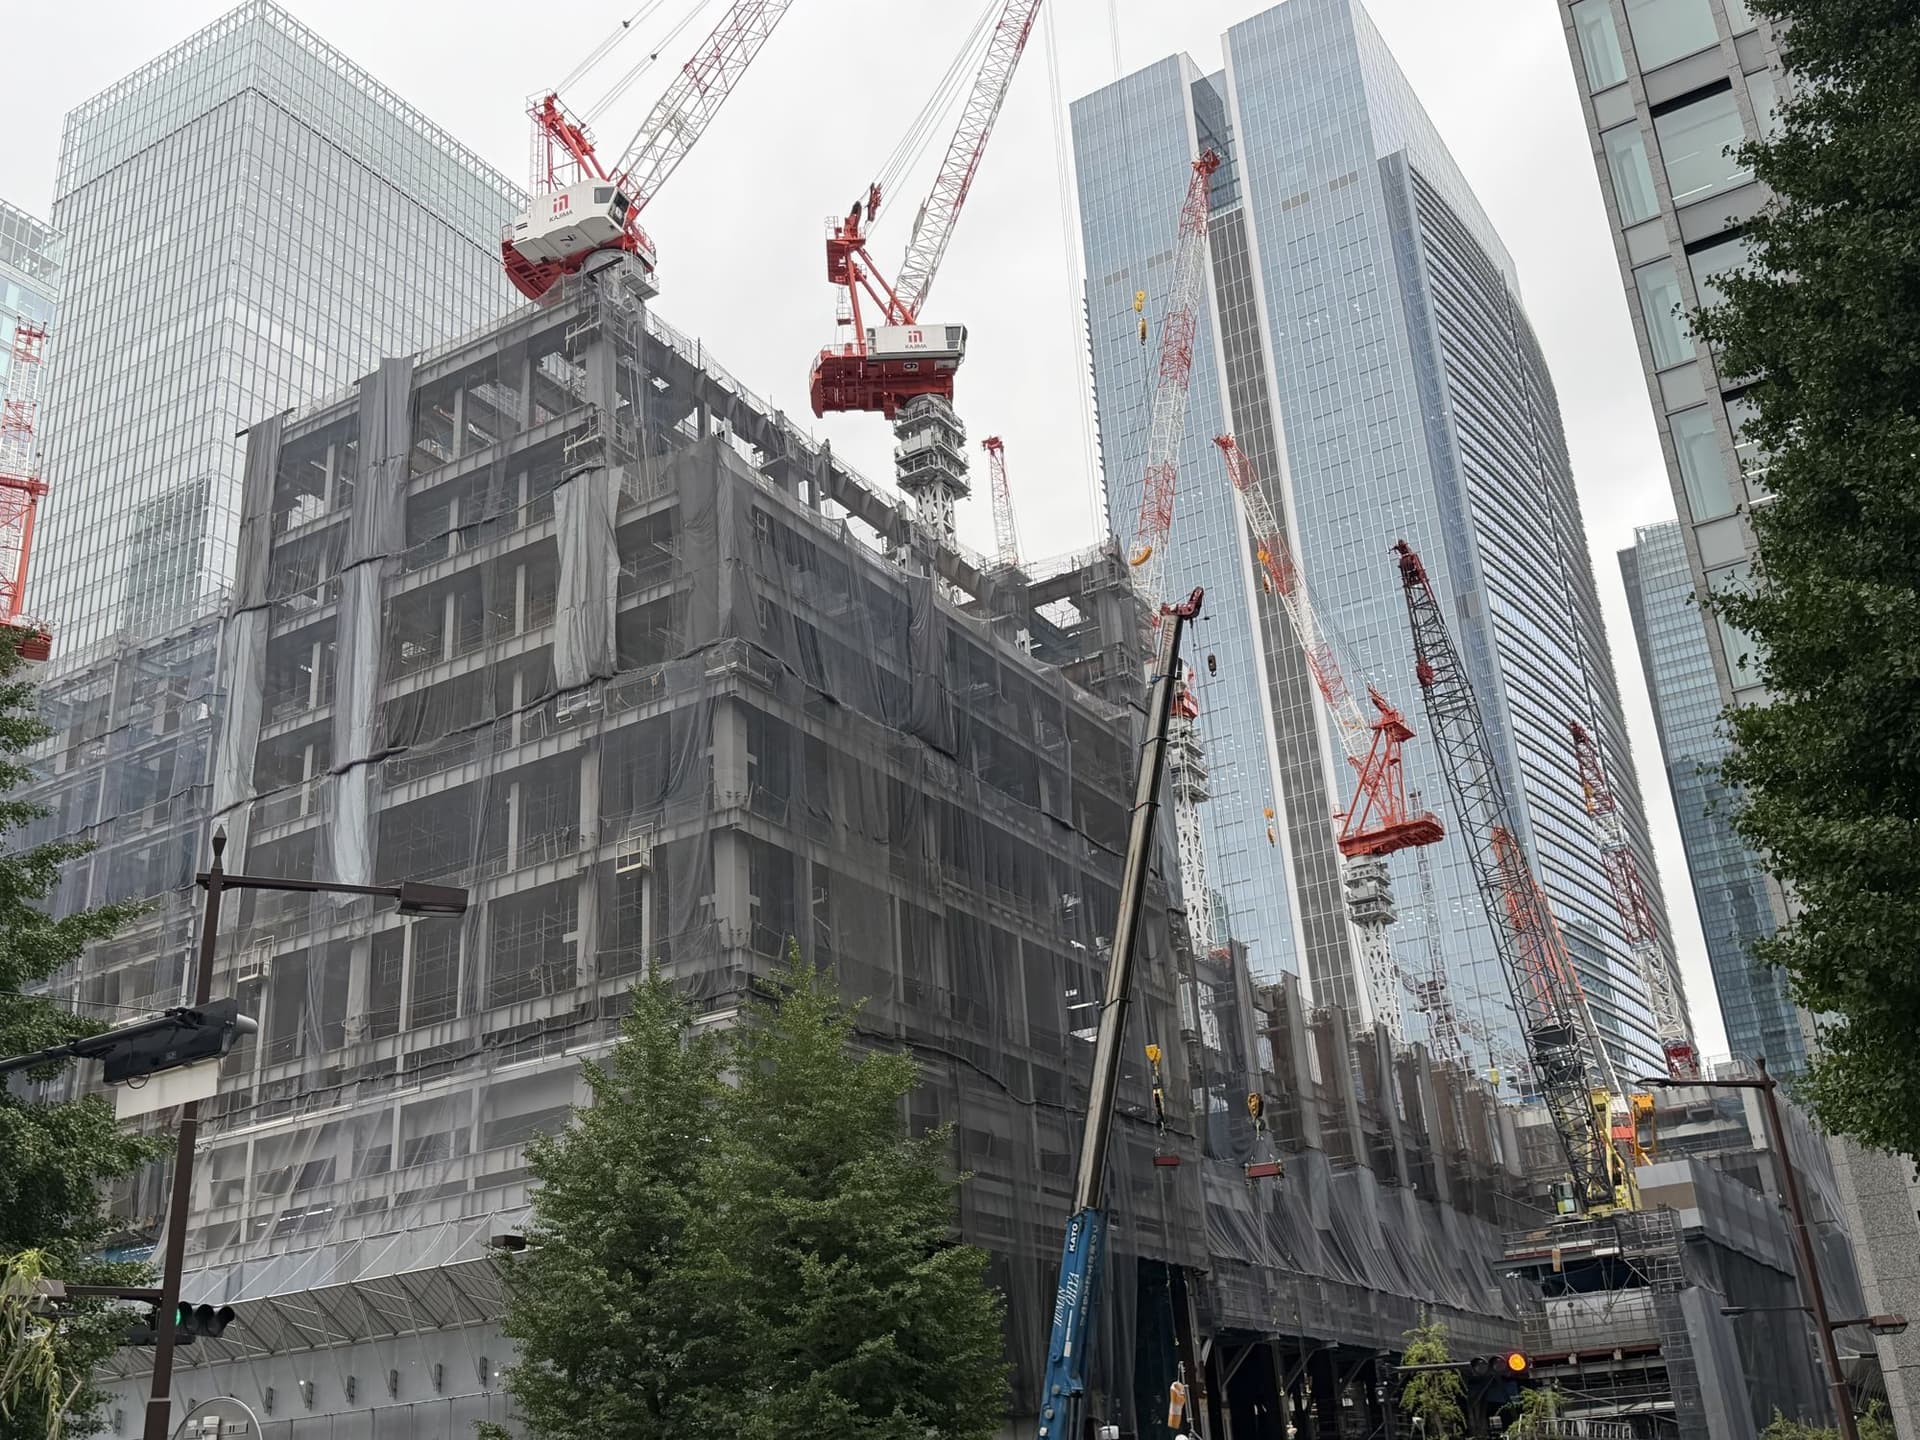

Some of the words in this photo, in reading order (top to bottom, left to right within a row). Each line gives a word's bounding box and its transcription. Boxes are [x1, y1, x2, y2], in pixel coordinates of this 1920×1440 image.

[549, 210, 573, 222] KAJIMA
[1068, 1223, 1079, 1253] KATO
[1065, 1271, 1080, 1307] OHYA
[1053, 1286, 1066, 1328] HUMAN
